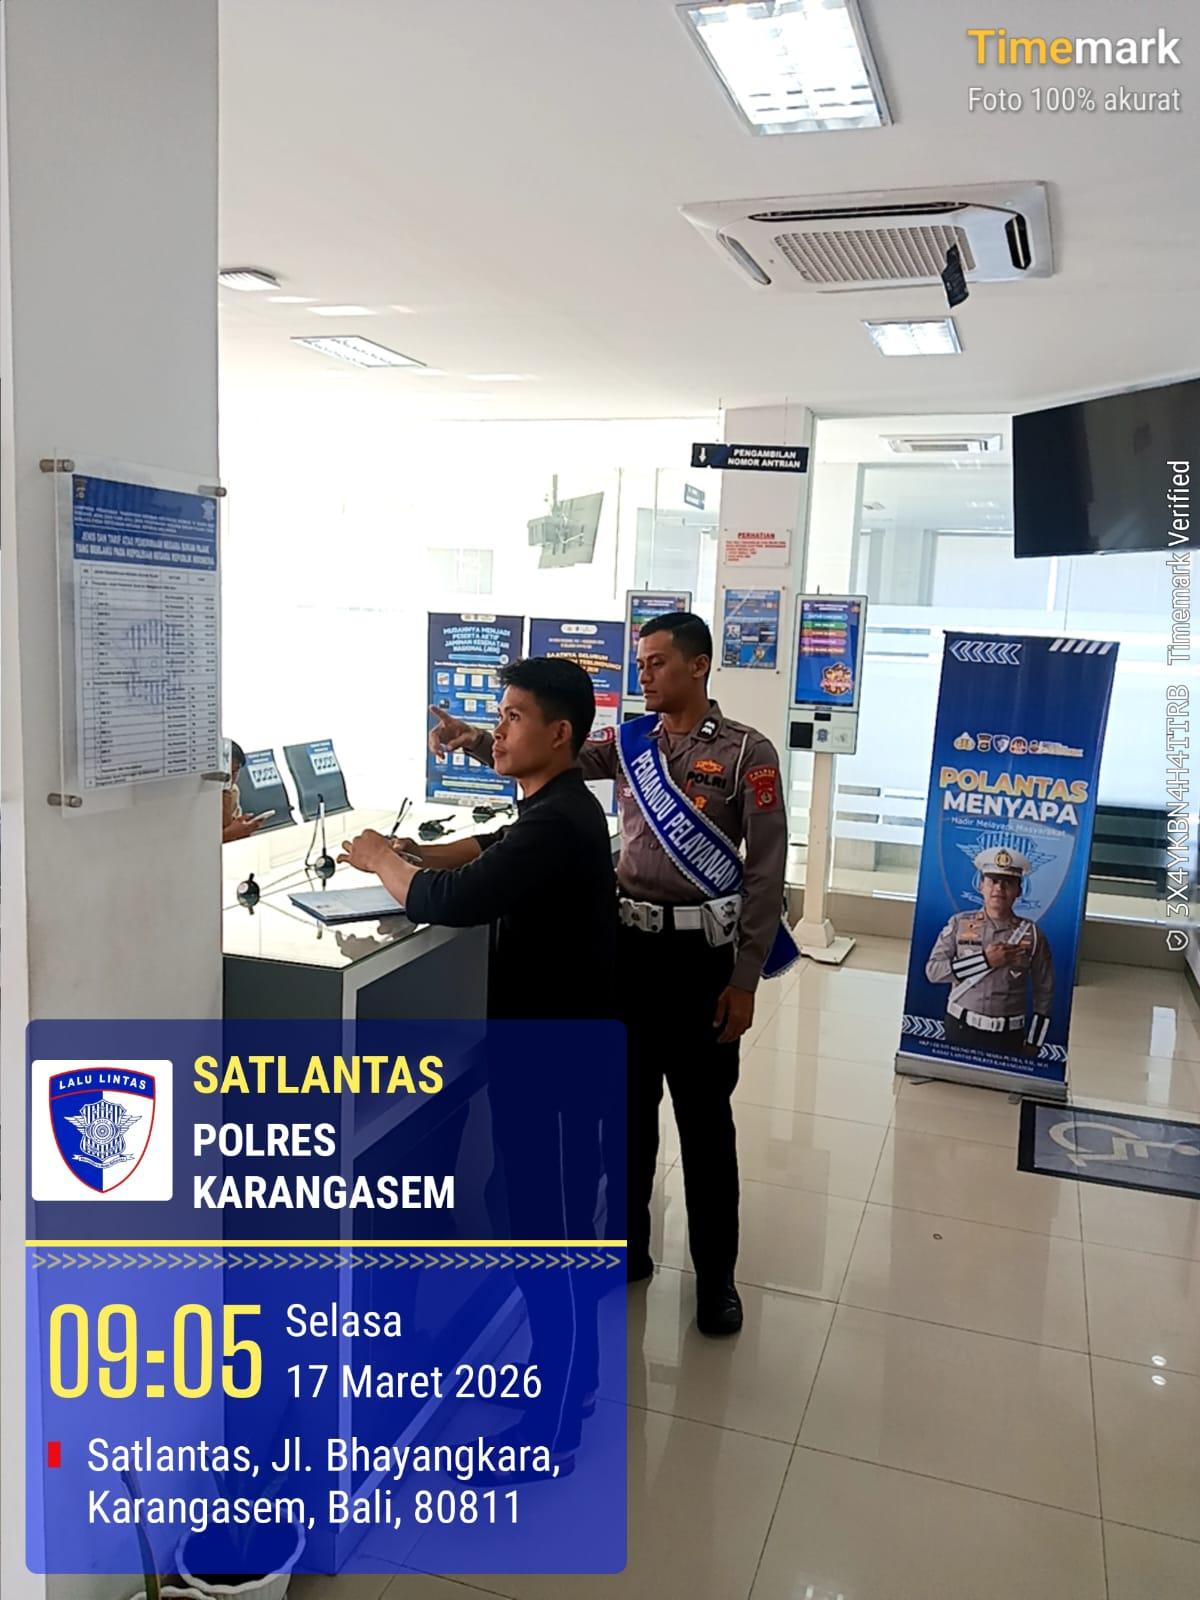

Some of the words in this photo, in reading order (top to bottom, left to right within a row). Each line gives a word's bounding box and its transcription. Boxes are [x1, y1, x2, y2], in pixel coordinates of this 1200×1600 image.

[728, 458, 760, 467] NOMOR
[761, 459, 801, 468] ANTRIAN
[733, 449, 796, 459] PENGAMBILAN
[737, 532, 776, 540] PERHATIAN
[687, 771, 726, 789] POLRI
[939, 766, 1088, 803] POLANTAS
[943, 791, 1078, 826] MENYAPA
[631, 749, 678, 822] PEMANDU
[663, 811, 739, 892] PELAYANAN
[951, 816, 974, 826] Hadir
[977, 819, 1011, 832] Melayani
[1016, 824, 1066, 837] Masyarakat
